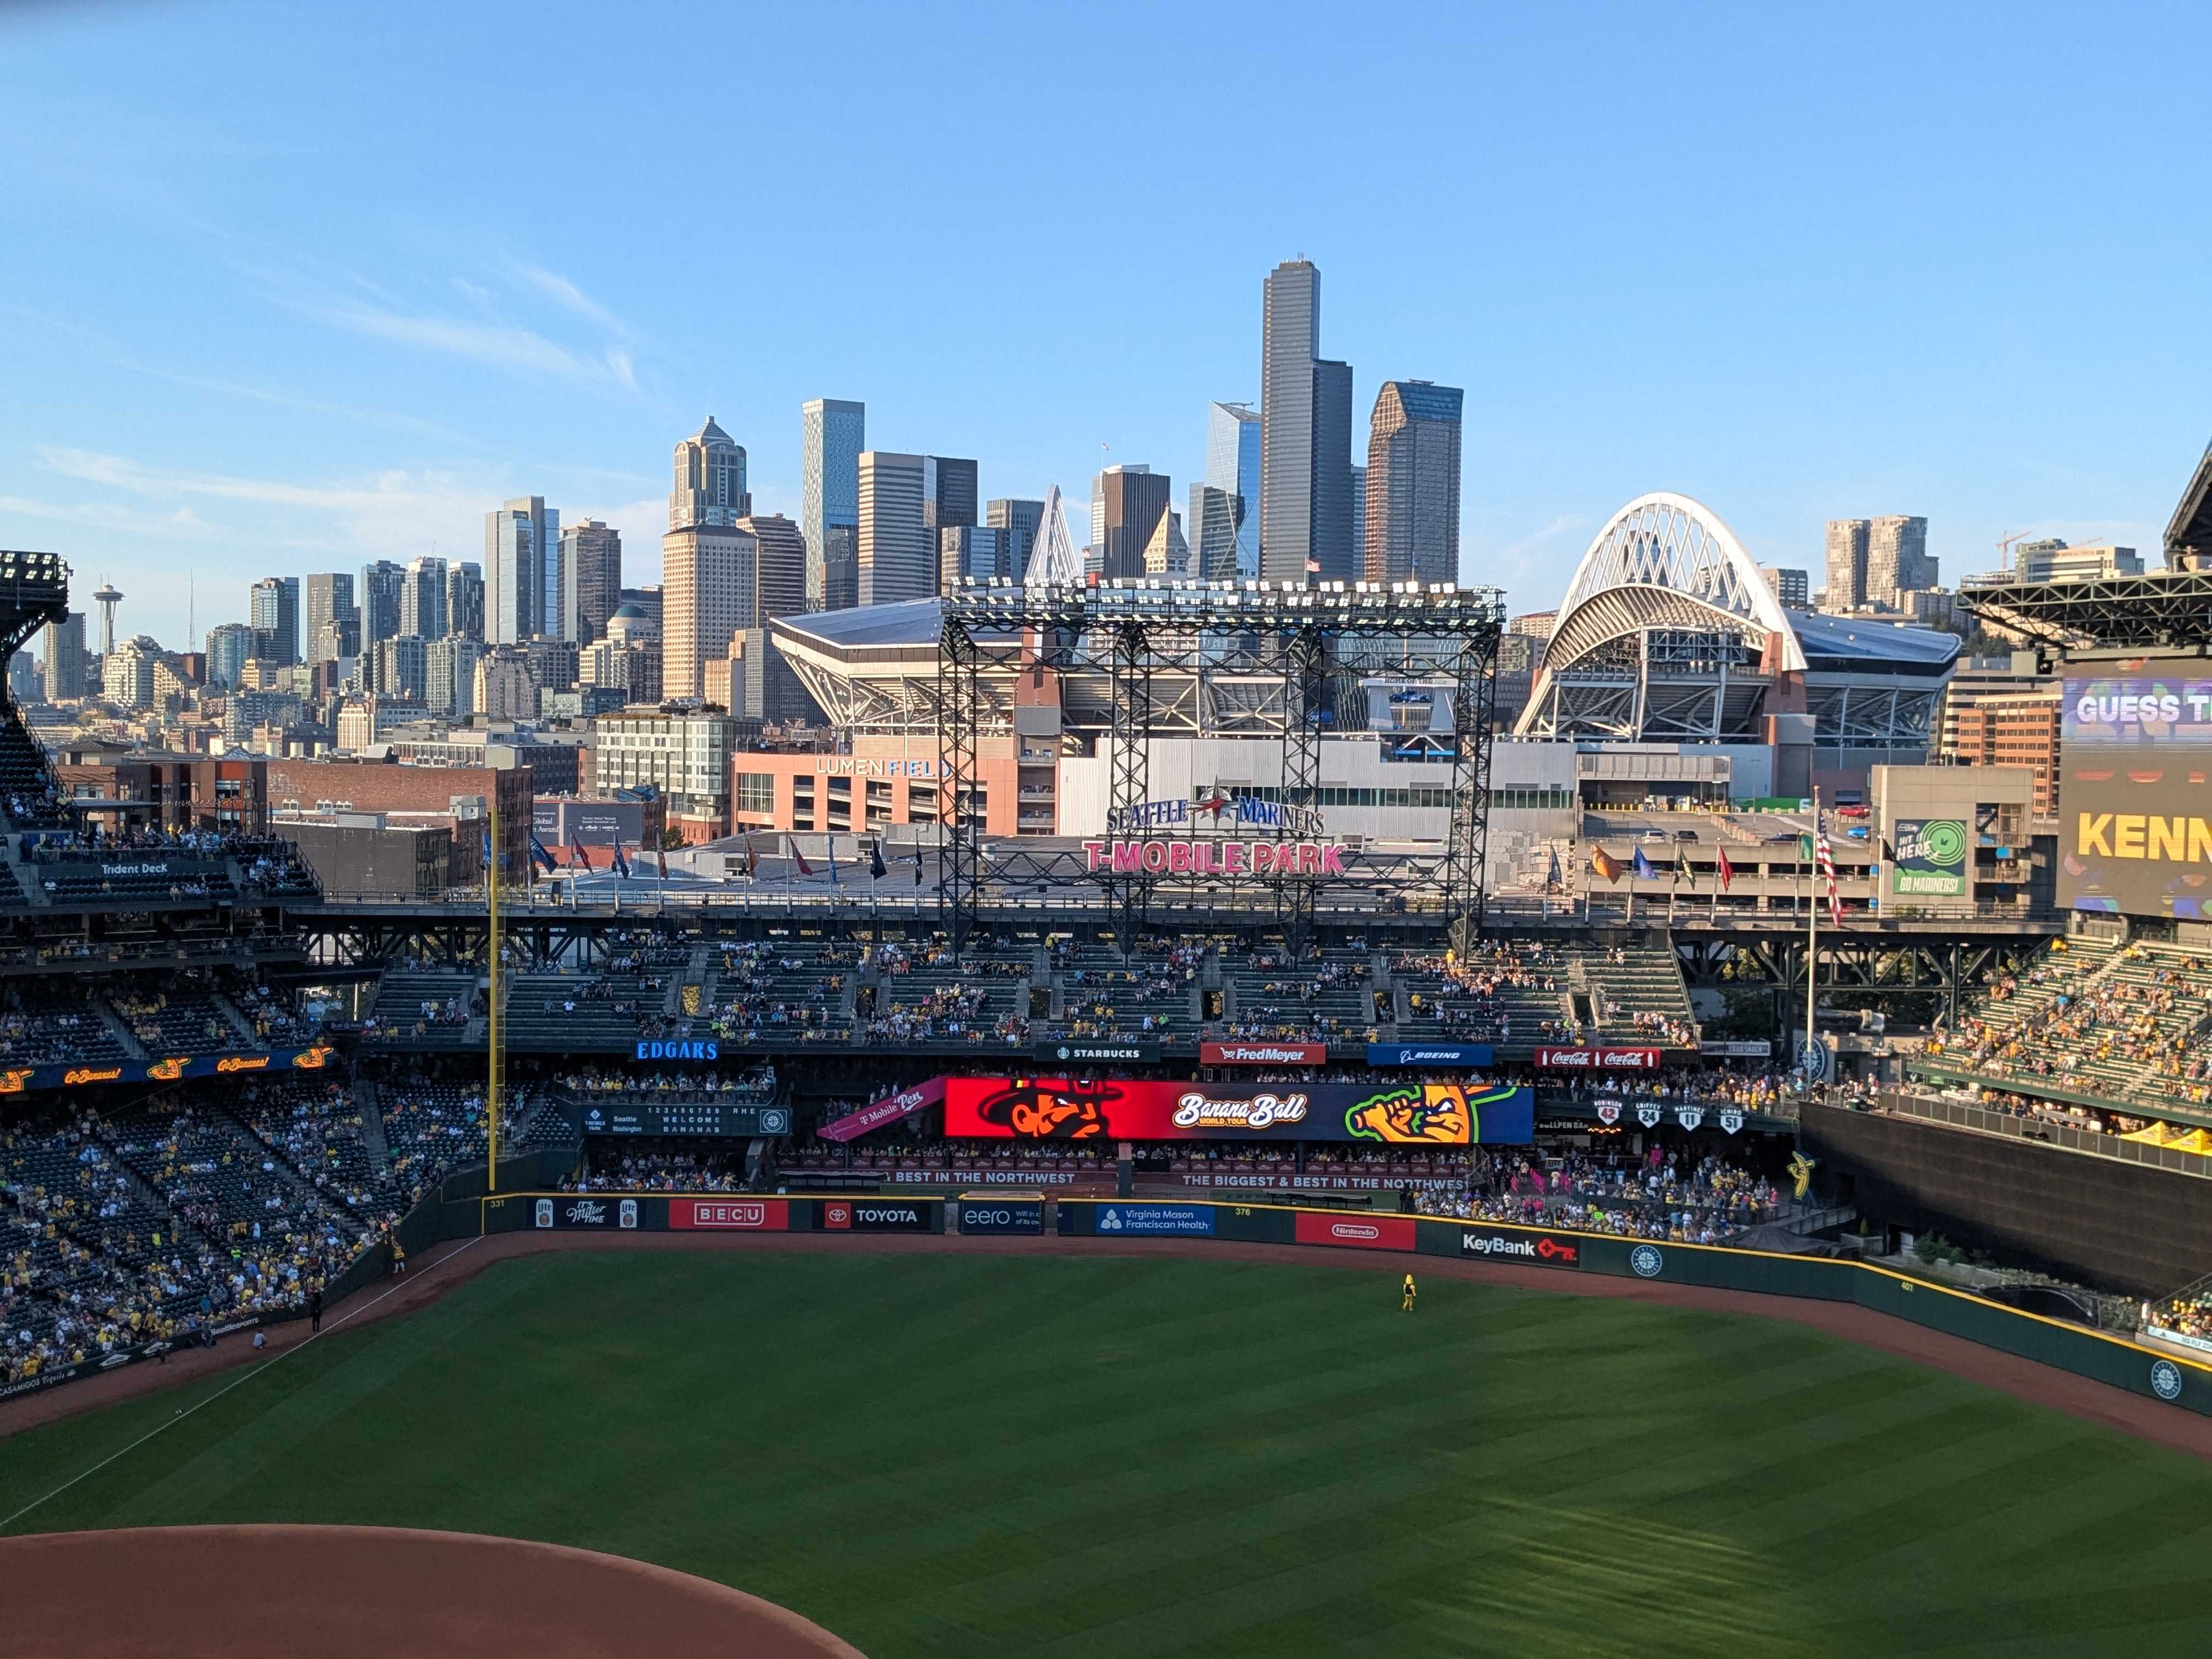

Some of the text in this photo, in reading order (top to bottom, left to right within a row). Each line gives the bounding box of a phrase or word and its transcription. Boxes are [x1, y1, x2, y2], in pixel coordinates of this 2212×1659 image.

[2077, 695, 2180, 723] GUESS
[816, 758, 952, 778] LUMEN FIELD
[1106, 795, 1325, 834] SEATTLE MARINERS
[1899, 832, 1923, 846] HIT IT
[1896, 840, 1932, 861] HERE
[1082, 840, 1350, 874] T-MOBILE PARK
[101, 864, 168, 874] Trident Deck
[1900, 877, 1959, 893] GO MARINERS!
[1074, 1049, 1140, 1058] STARBUCKS
[217, 1059, 231, 1071] Go
[64, 1070, 78, 1084] Go
[1173, 1093, 1306, 1126] Banana Ball
[1594, 1099, 1622, 1108] ROBINSON
[1635, 1102, 1661, 1110] GRIFFEY
[868, 1104, 898, 1122] Mobile
[1600, 1108, 1616, 1120] 42
[1641, 1110, 1656, 1122] 24
[1674, 1105, 1705, 1115] MARTINEZ
[1684, 1114, 1695, 1125] 11
[1725, 1117, 1738, 1128] 51
[896, 1172, 931, 1182] BEST
[935, 1172, 949, 1182] IN
[954, 1172, 981, 1182] THE
[986, 1172, 1075, 1183] NORTHWEST
[1183, 1175, 1210, 1186] THE
[1215, 1176, 1275, 1186] BIGGEST
[1279, 1176, 1288, 1187] &
[1294, 1177, 1329, 1188] BEST
[1333, 1178, 1347, 1188] IN
[1352, 1178, 1379, 1188] THE
[566, 1205, 607, 1223] Miller
[584, 1215, 605, 1223] TIME
[700, 1208, 759, 1221] BECU
[856, 1210, 917, 1222] TOYOTA
[965, 1210, 1010, 1224] eero
[1126, 1210, 1194, 1220] Virginia Mason
[1126, 1220, 1209, 1229] Franciscan Health
[1335, 1227, 1375, 1237] Nintendo
[1463, 1234, 1536, 1257] KeyBank
